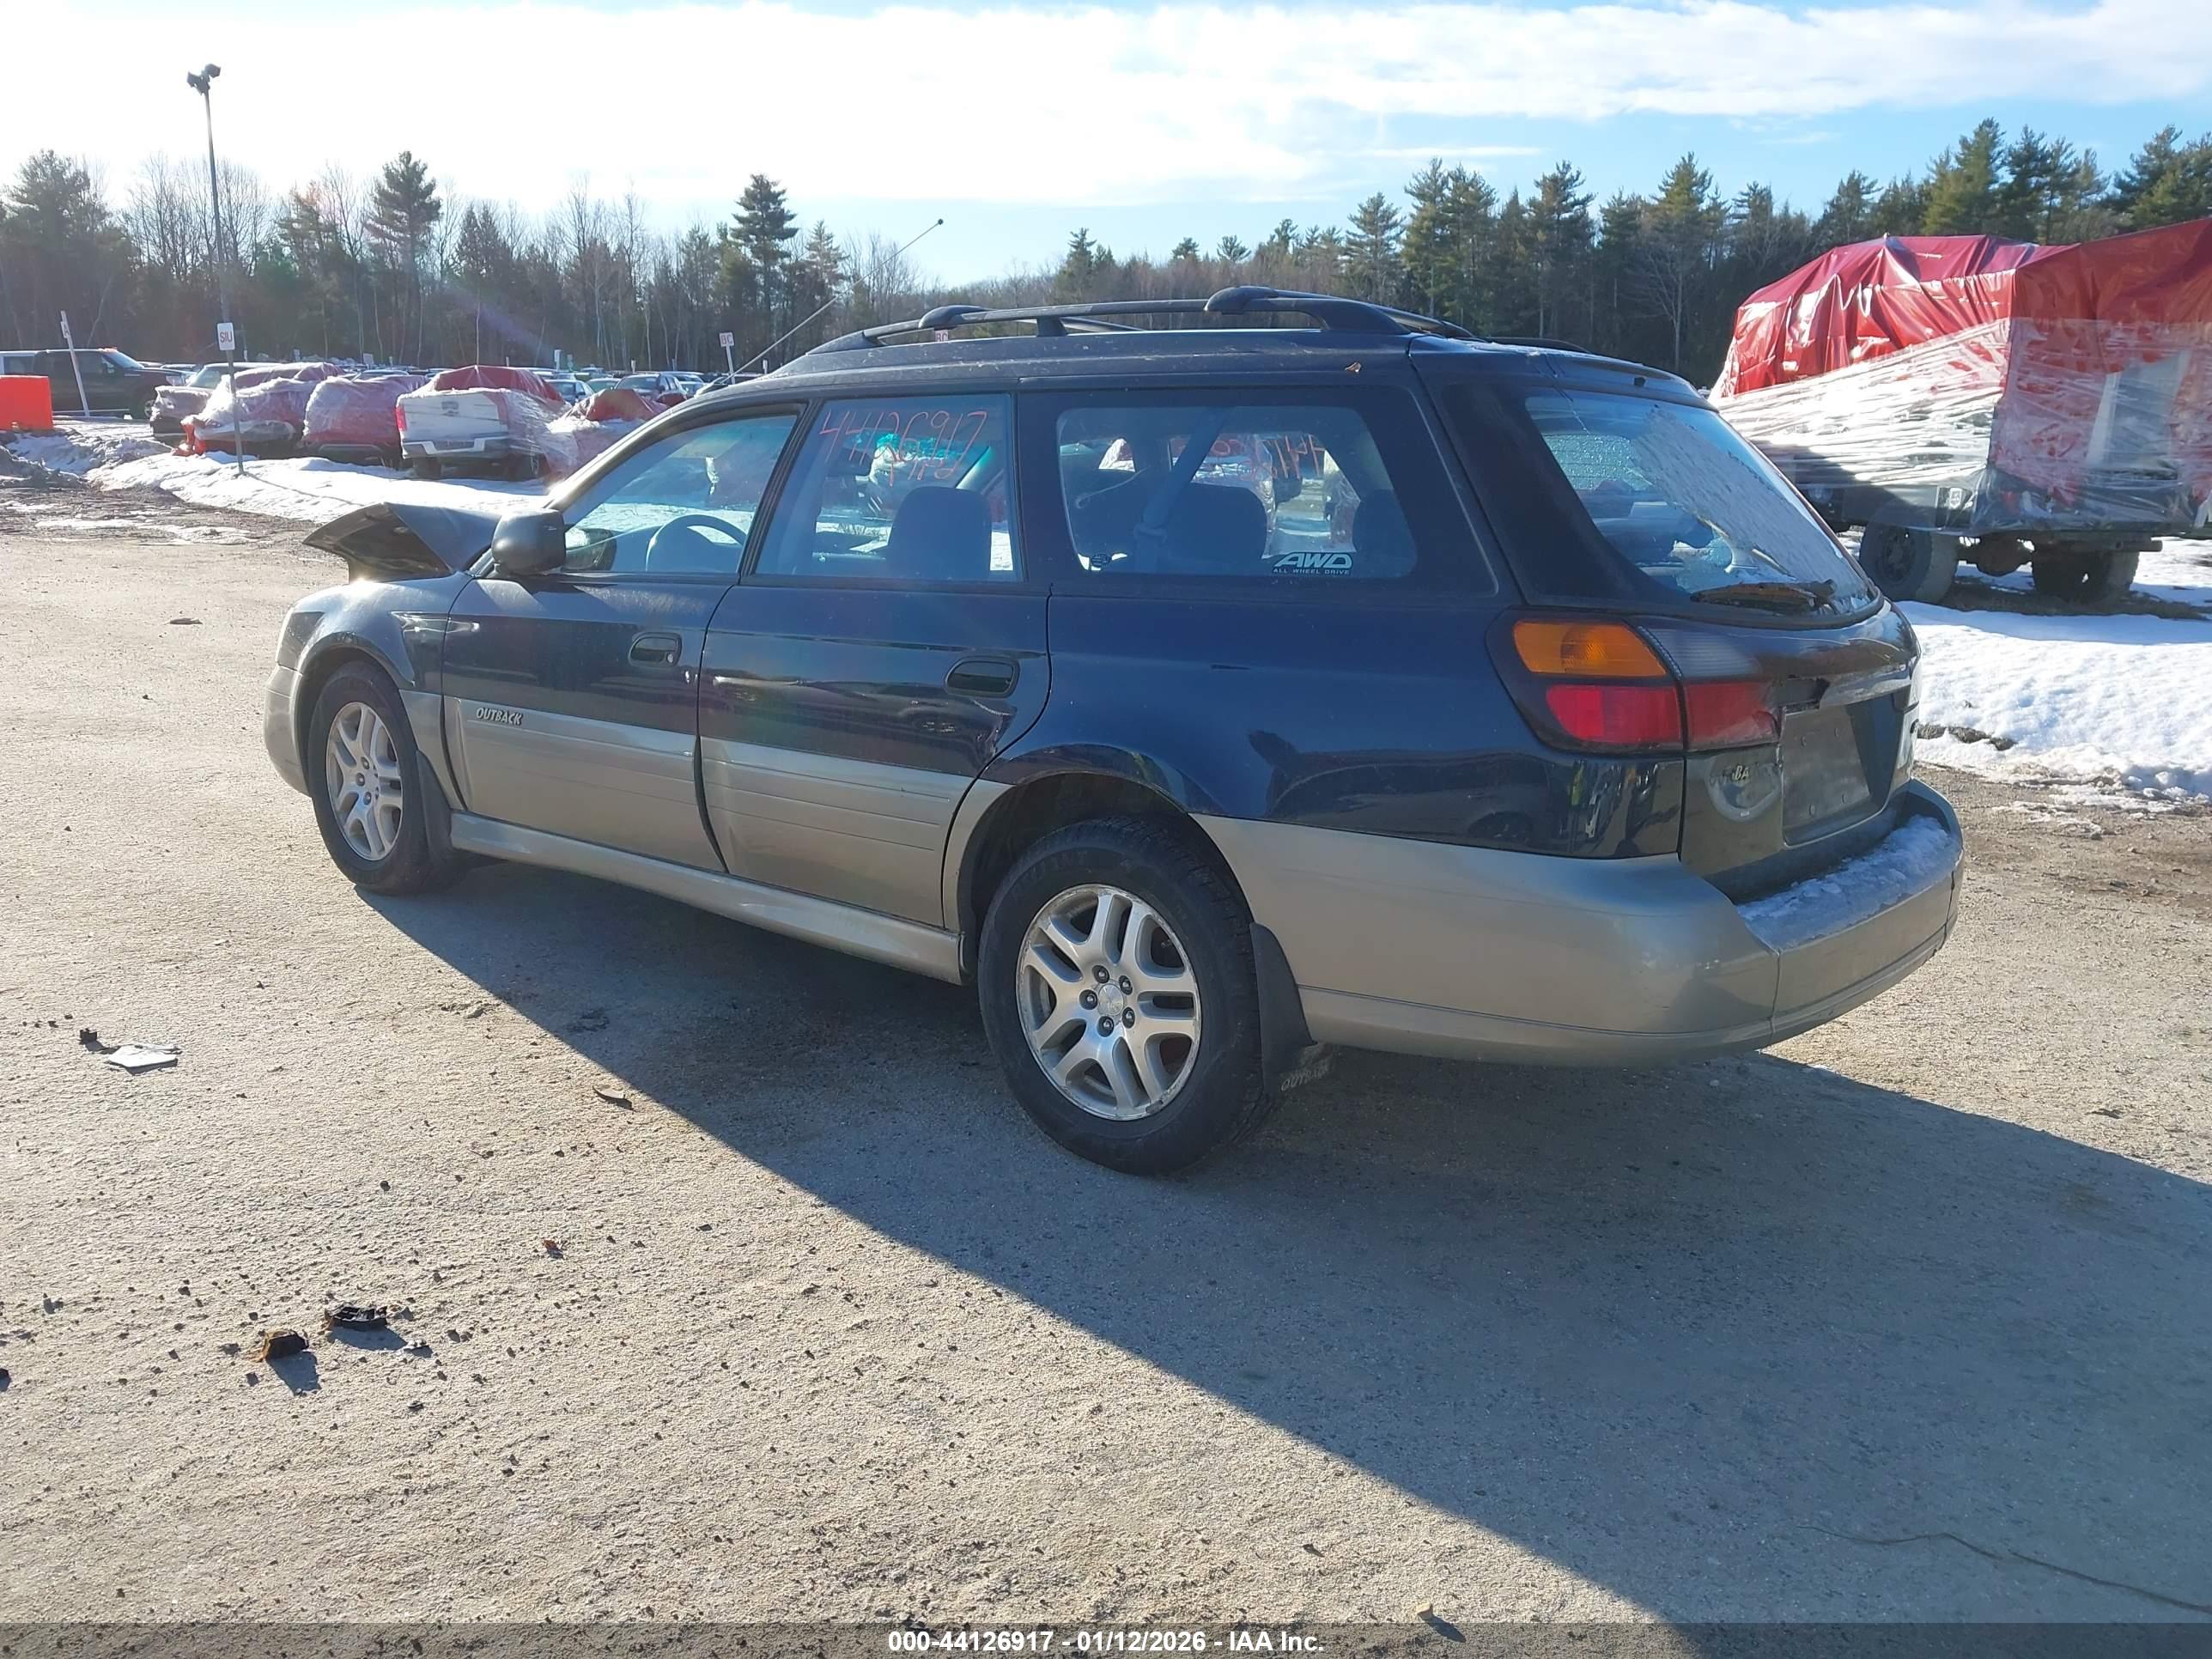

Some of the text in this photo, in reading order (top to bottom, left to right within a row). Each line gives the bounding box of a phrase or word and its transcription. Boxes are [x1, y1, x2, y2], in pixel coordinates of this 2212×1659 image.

[819, 410, 988, 471] 44126917
[1273, 552, 1352, 568] AWD
[476, 707, 523, 726] OUTBACK
